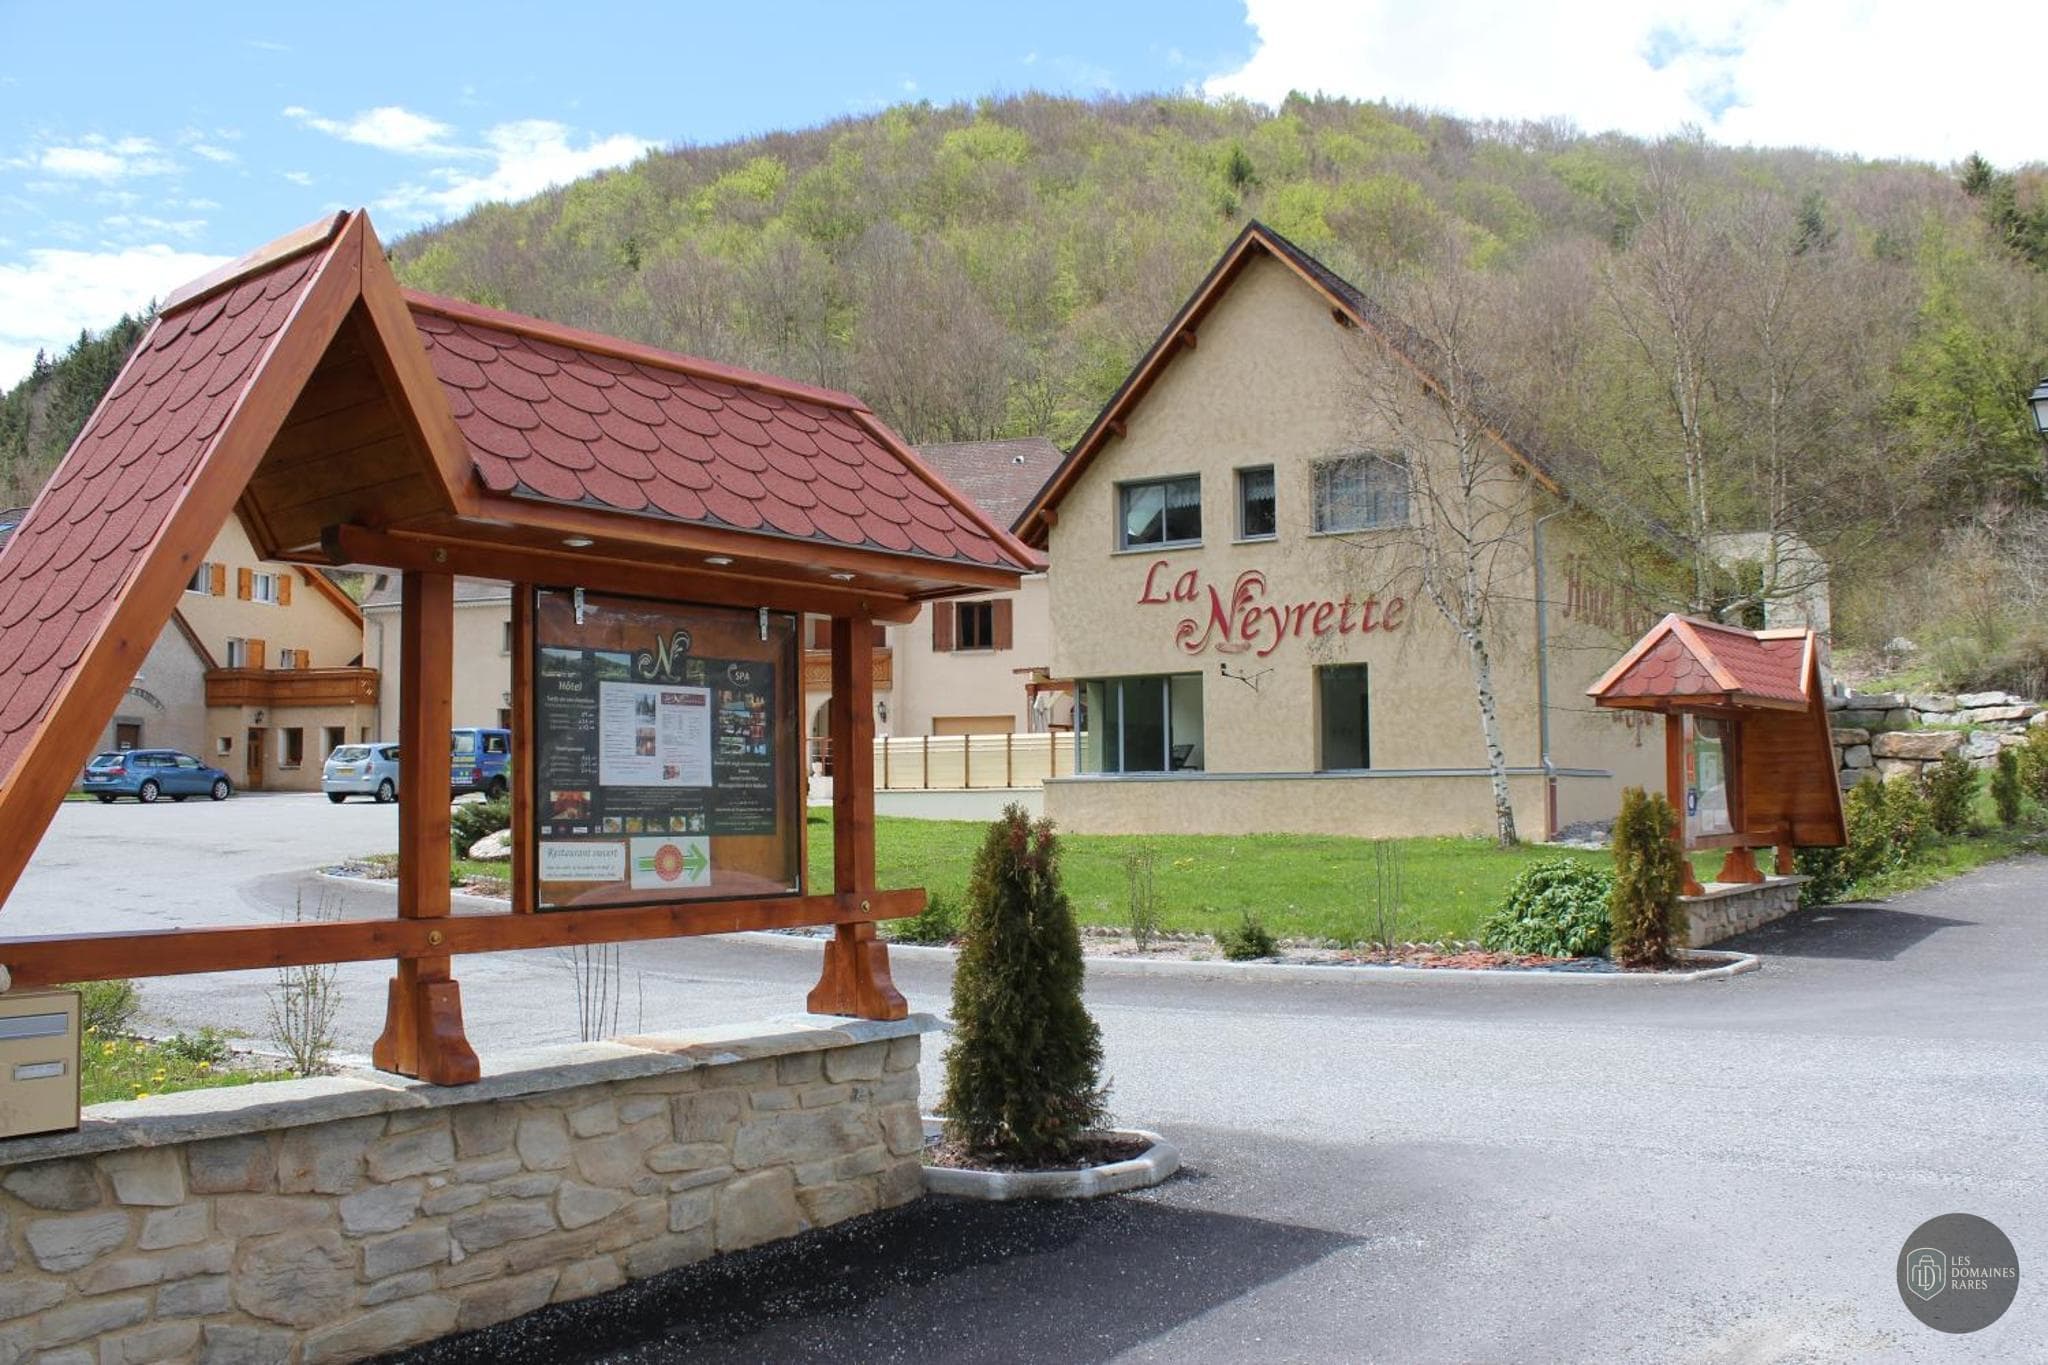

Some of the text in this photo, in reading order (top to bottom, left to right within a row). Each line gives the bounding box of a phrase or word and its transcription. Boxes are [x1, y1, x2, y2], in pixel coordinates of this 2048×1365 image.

[1137, 560, 1405, 657] La Neyrette
[735, 670, 751, 681] SPA
[558, 680, 583, 692] Hôtel
